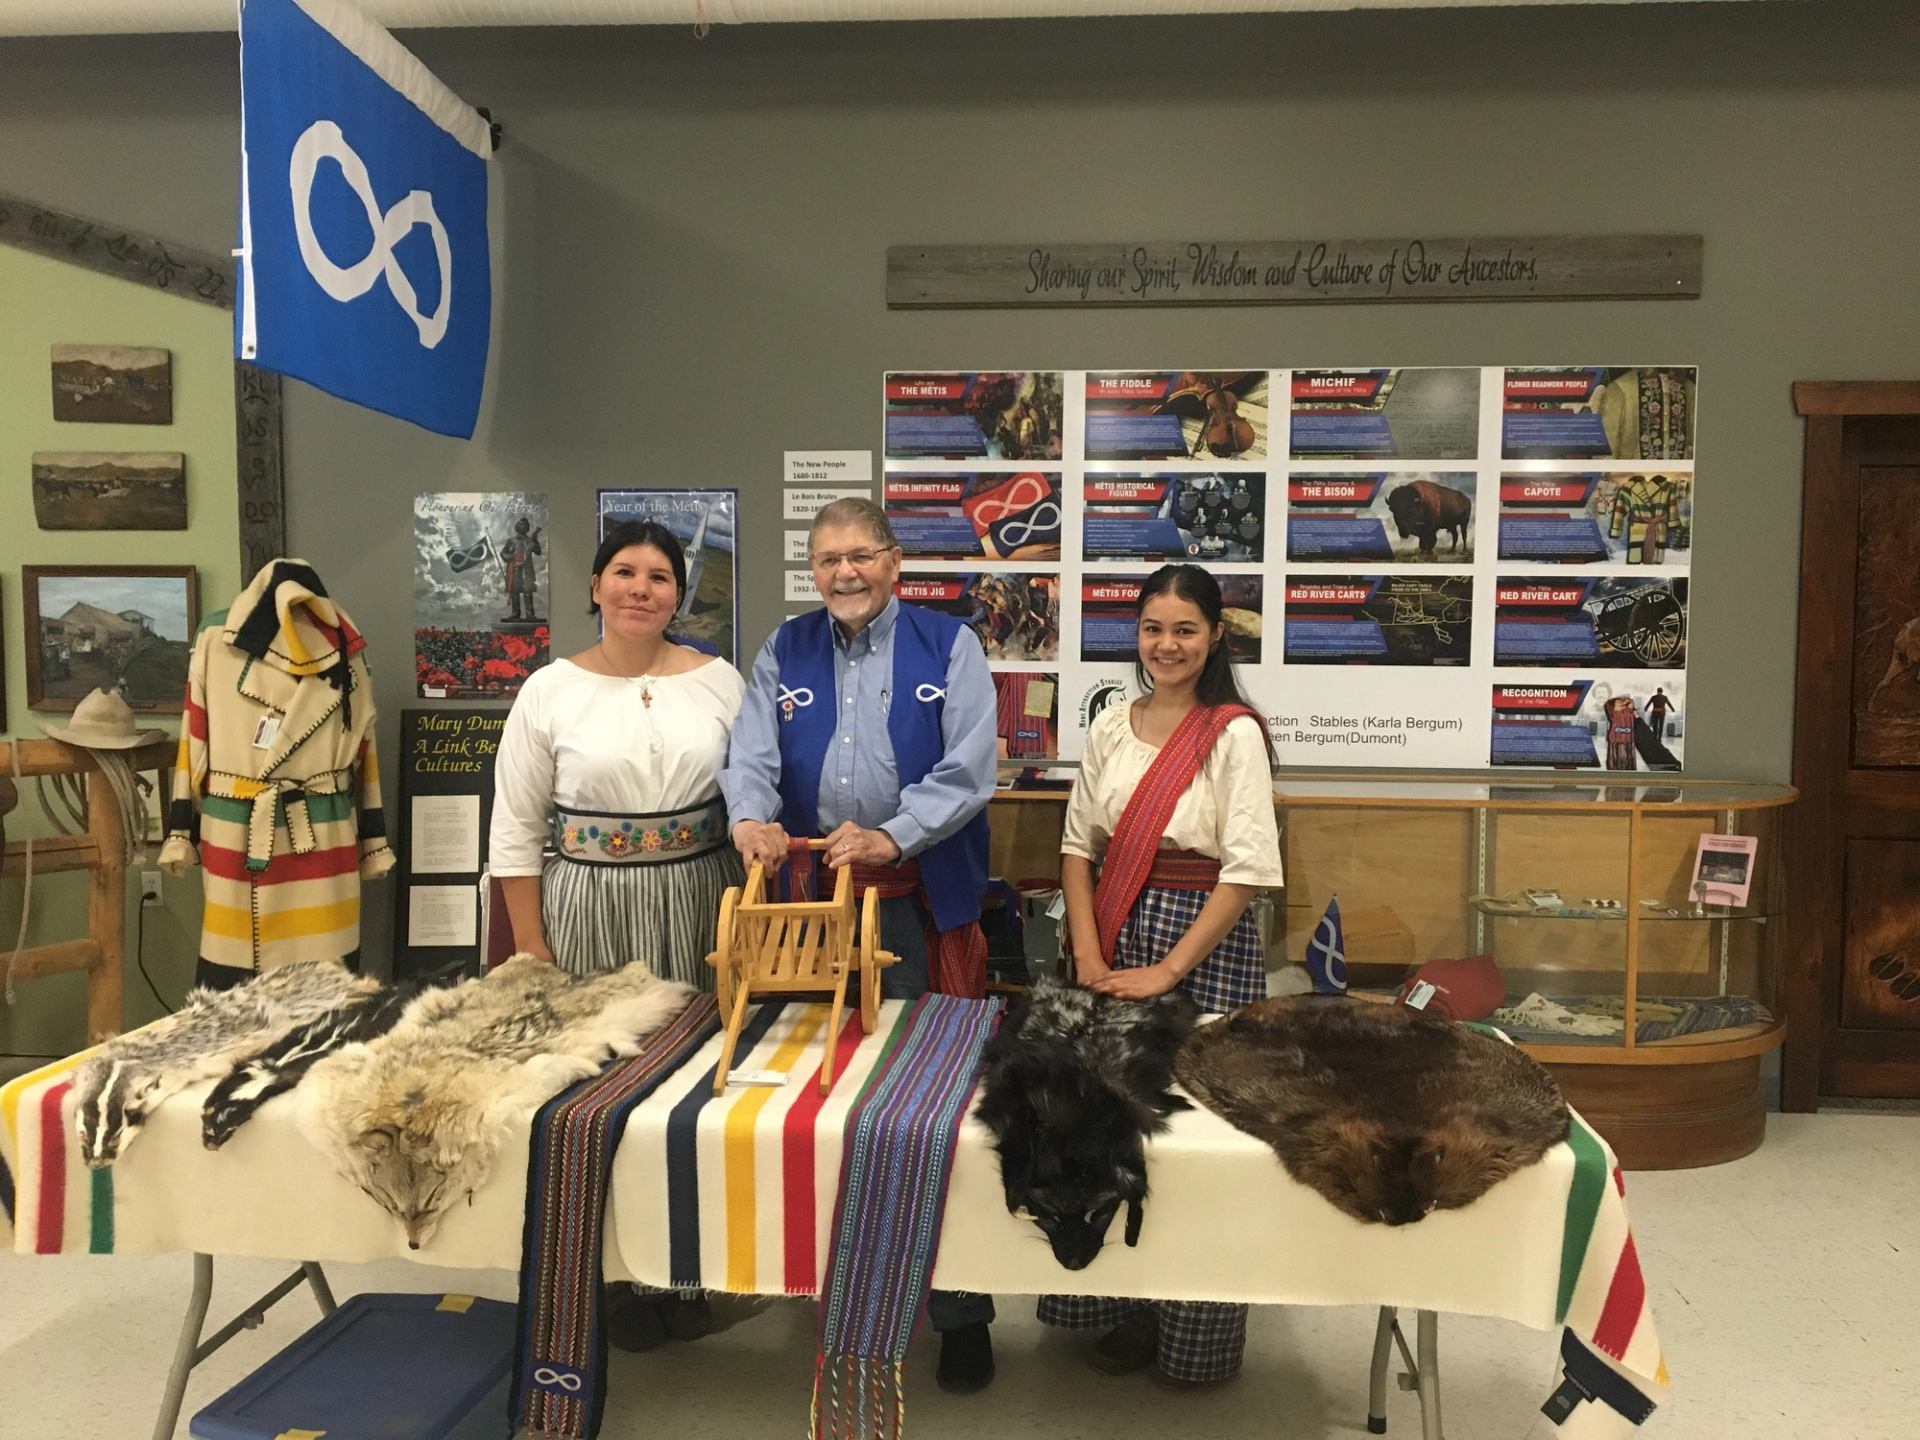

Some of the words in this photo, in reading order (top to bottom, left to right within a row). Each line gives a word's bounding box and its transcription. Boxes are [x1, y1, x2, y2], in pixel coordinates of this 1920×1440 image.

[1025, 248, 1091, 300] Sharing
[1097, 266, 1126, 289] our
[1131, 247, 1180, 298] Spirit,
[1187, 243, 1257, 287] Wisdom
[1265, 250, 1302, 286] and
[1303, 243, 1372, 288] Culture
[1379, 248, 1399, 294] of
[1403, 240, 1442, 285] Our
[1448, 245, 1538, 285] Ancestors.
[1100, 379, 1118, 388] THE
[1120, 379, 1152, 388] FIDDLE
[1311, 377, 1357, 387] MICHIF
[900, 386, 918, 395] THE
[911, 484, 941, 492] INFINITY
[942, 484, 960, 492] FLAG
[1116, 482, 1155, 490] HISTORICAL
[1302, 487, 1321, 496] THE
[1324, 487, 1355, 496] BISON
[1524, 488, 1561, 496] CAPOTE
[607, 500, 632, 512] Year
[635, 499, 648, 512] of
[650, 500, 668, 512] the
[930, 587, 945, 596] JIG
[1093, 586, 1119, 597] MÉTIS
[1122, 589, 1140, 598] FOO
[1291, 590, 1308, 598] RED
[1310, 590, 1335, 598] RIVER
[1338, 590, 1366, 598] CARTS
[1500, 592, 1519, 600] RED
[1522, 592, 1550, 600] RIVER
[1552, 592, 1578, 600] CART
[1502, 689, 1567, 697] RECOGNITION
[417, 713, 463, 737] Mary
[466, 715, 507, 731] Dum
[1265, 715, 1298, 727] ction
[1310, 715, 1358, 727] Stables
[1362, 716, 1402, 730] (Karla
[1406, 717, 1463, 732] Bergum)
[1295, 730, 1407, 747] Bergum(Dumont)
[413, 739, 428, 754] A
[432, 737, 472, 757] Link
[475, 739, 499, 754] Be
[415, 755, 483, 773] Cultures
